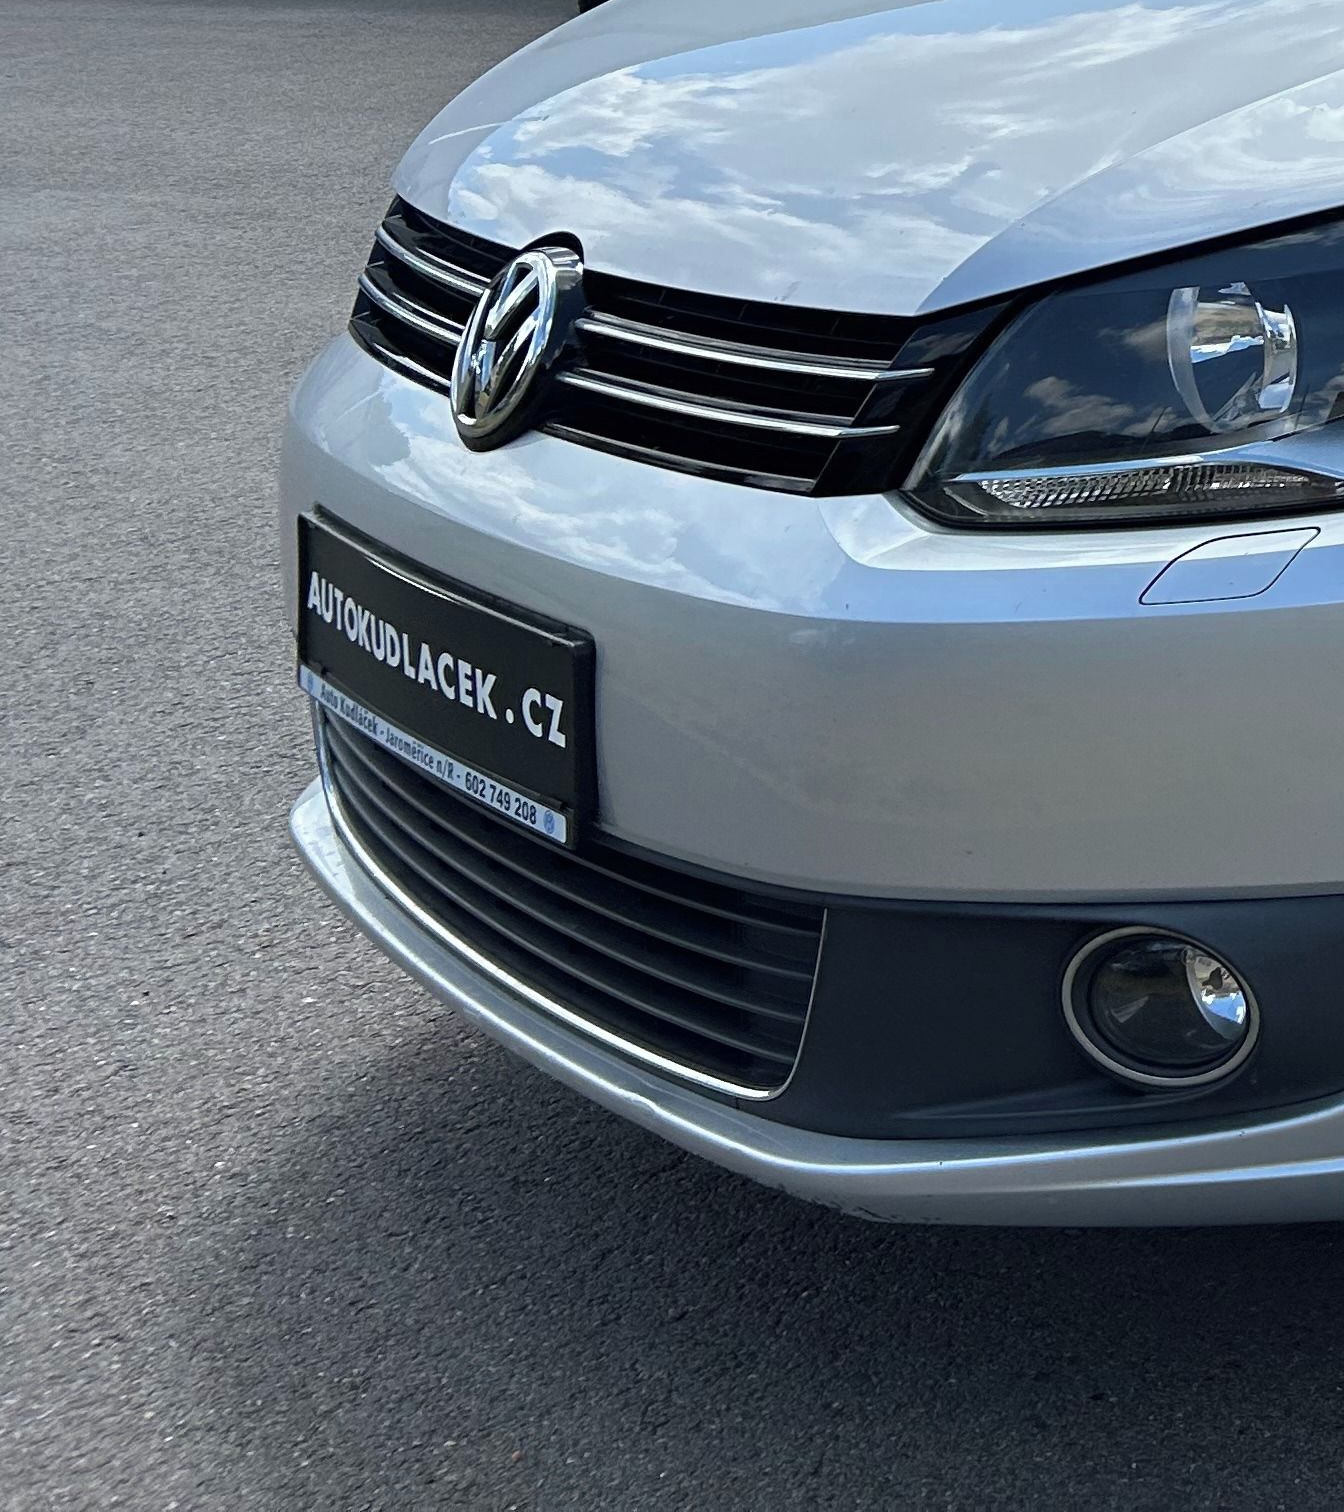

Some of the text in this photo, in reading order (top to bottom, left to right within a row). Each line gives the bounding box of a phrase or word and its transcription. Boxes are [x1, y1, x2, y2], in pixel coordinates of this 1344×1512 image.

[465, 771, 486, 798] 602
[489, 784, 511, 811] 749
[514, 797, 537, 825] 208
